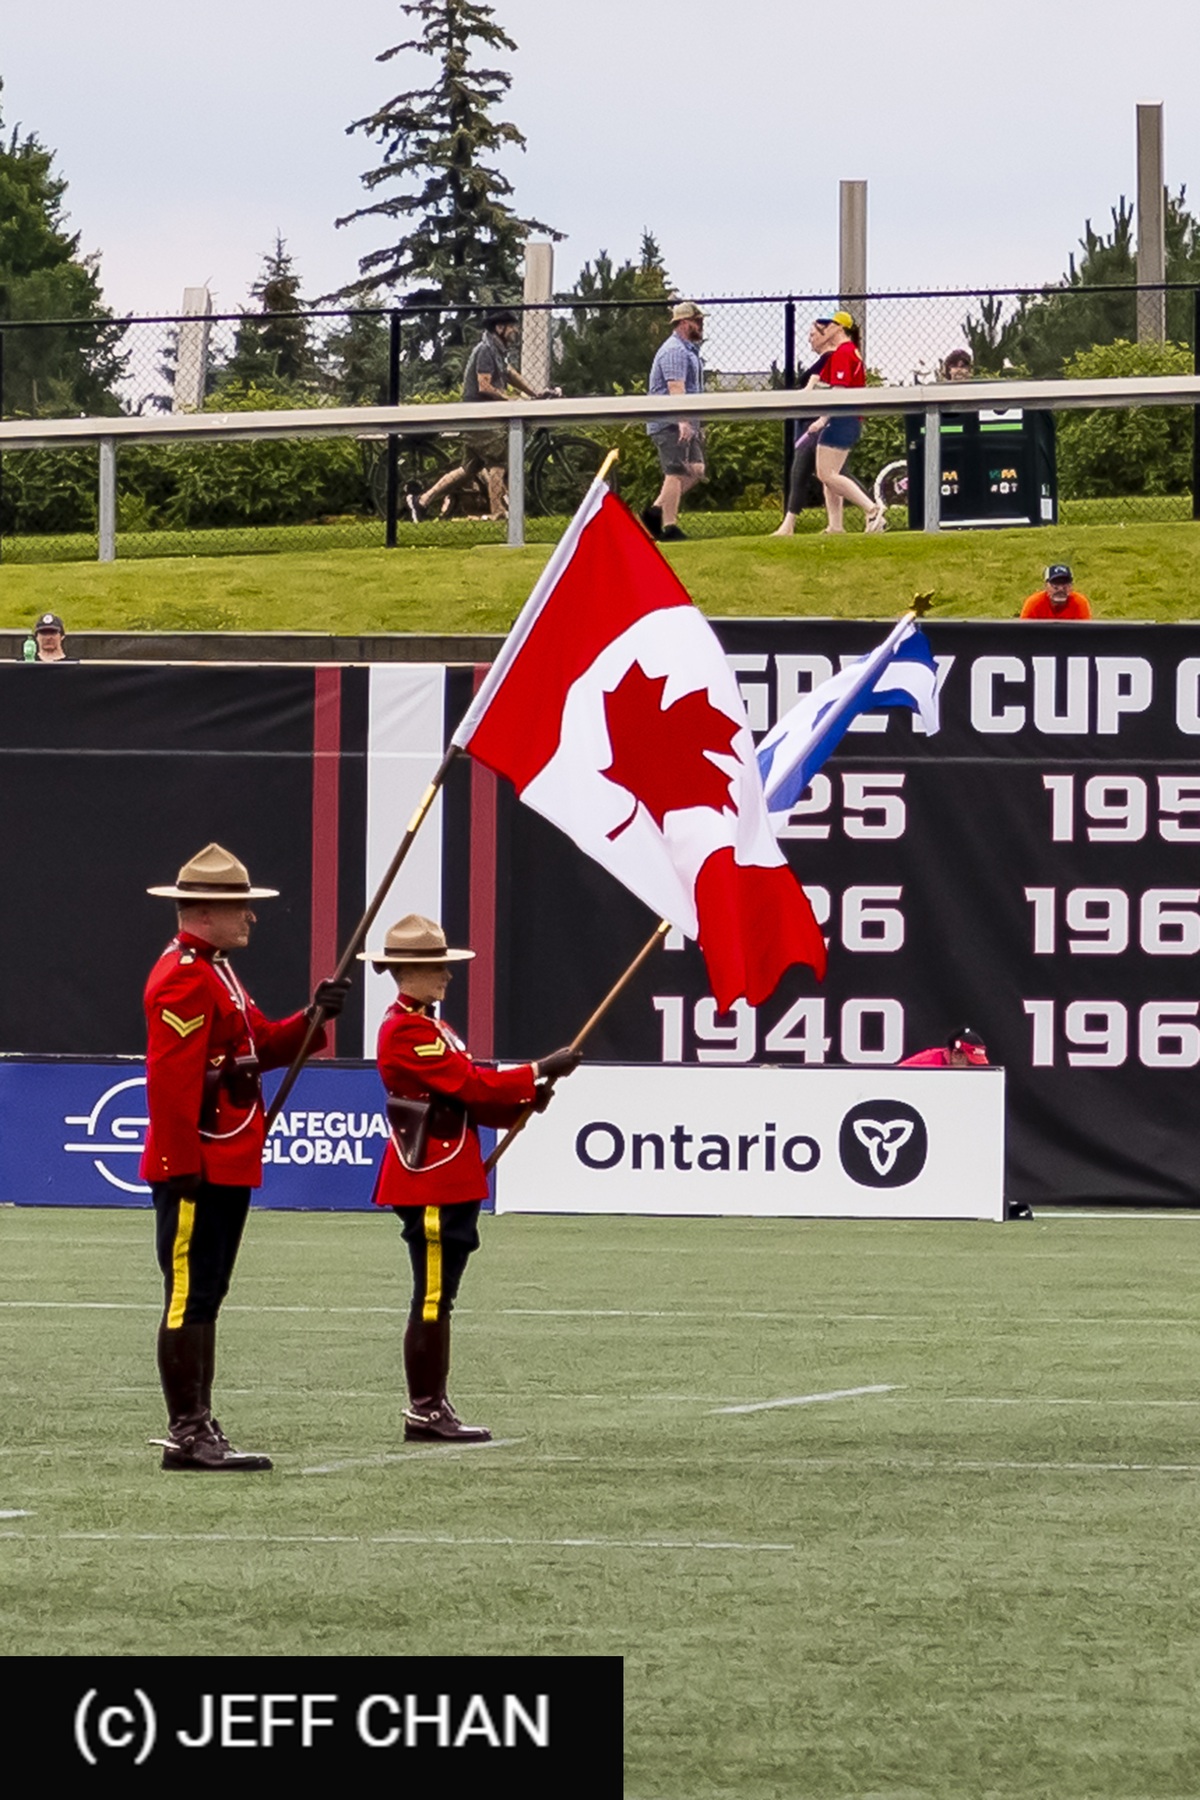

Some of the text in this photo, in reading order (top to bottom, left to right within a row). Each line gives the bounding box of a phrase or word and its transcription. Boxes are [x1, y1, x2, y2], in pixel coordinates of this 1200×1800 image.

[970, 656, 1153, 734] CUP
[776, 773, 906, 839] 25
[1024, 887, 1200, 955] 196
[652, 996, 905, 1064] 1940
[1023, 1000, 1200, 1068] 196
[267, 1111, 391, 1138] AFEGUA
[575, 1121, 821, 1173] Ontario
